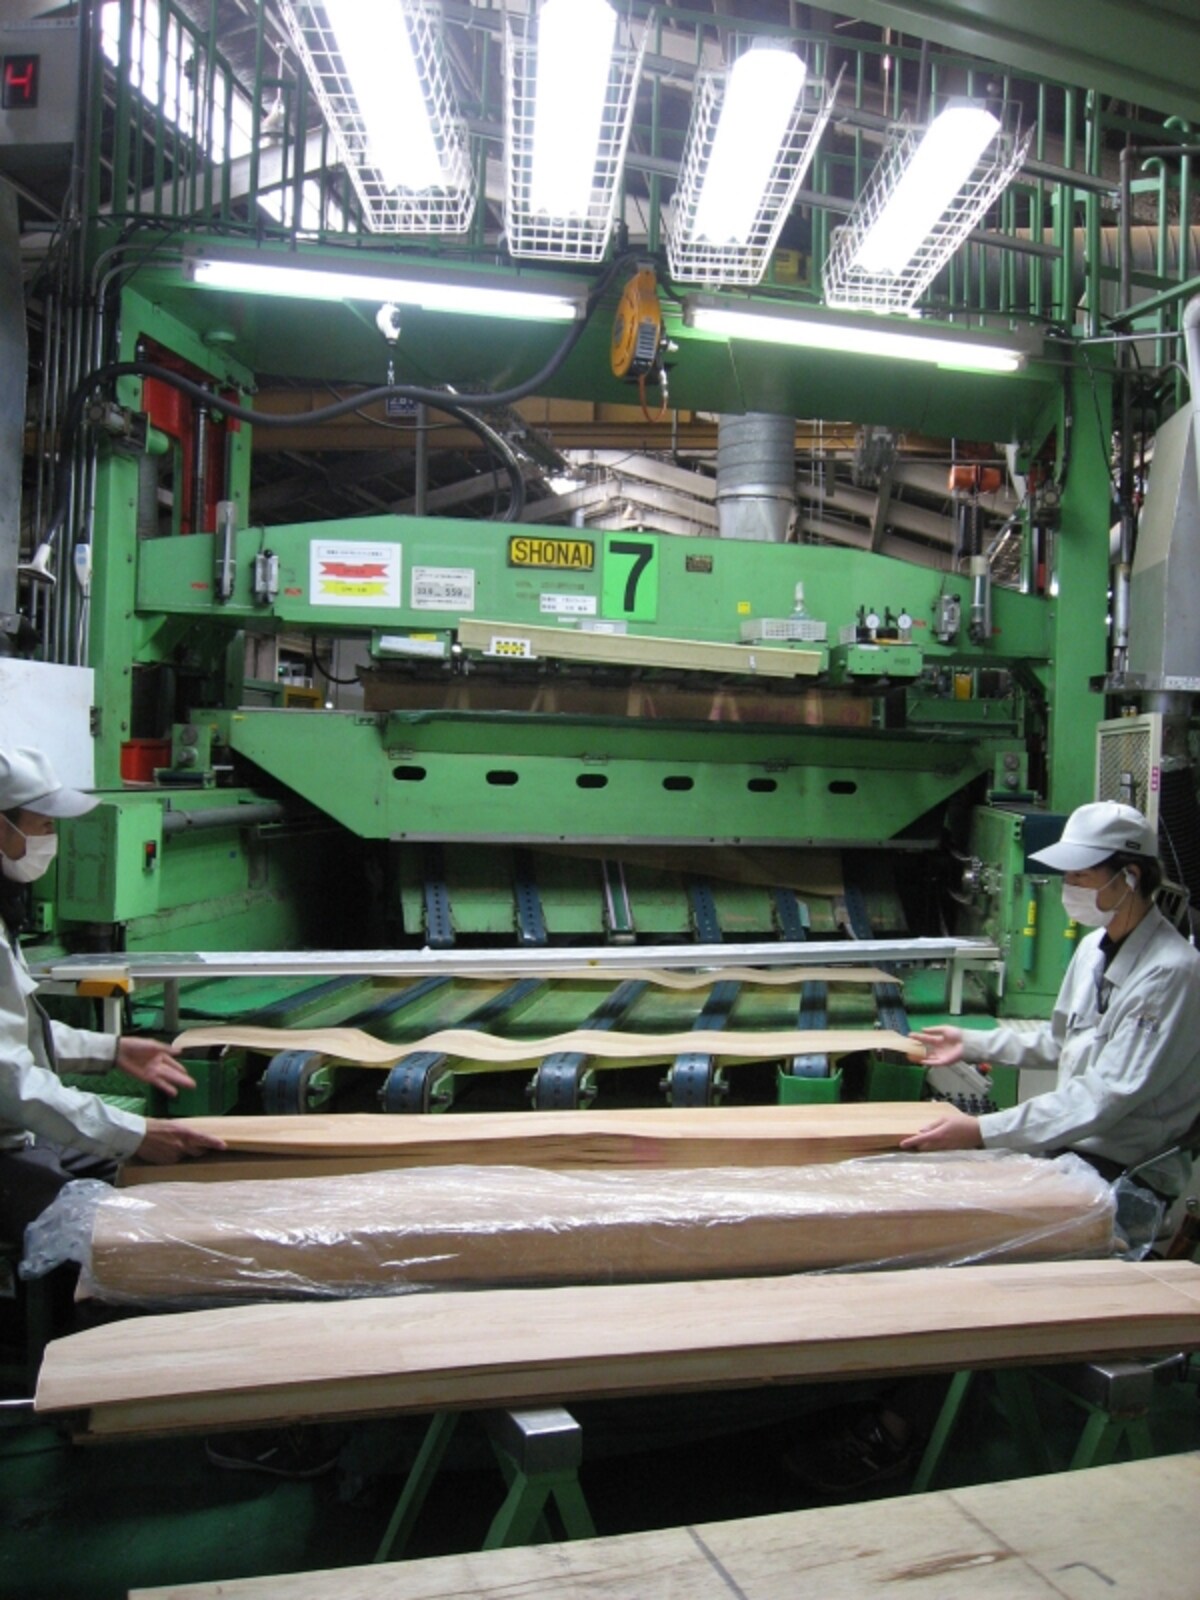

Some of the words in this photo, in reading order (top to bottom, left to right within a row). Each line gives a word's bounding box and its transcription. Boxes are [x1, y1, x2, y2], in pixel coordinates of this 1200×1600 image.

[5, 62, 33, 99] 4
[514, 540, 589, 566] SHONAI
[609, 540, 654, 613] 7
